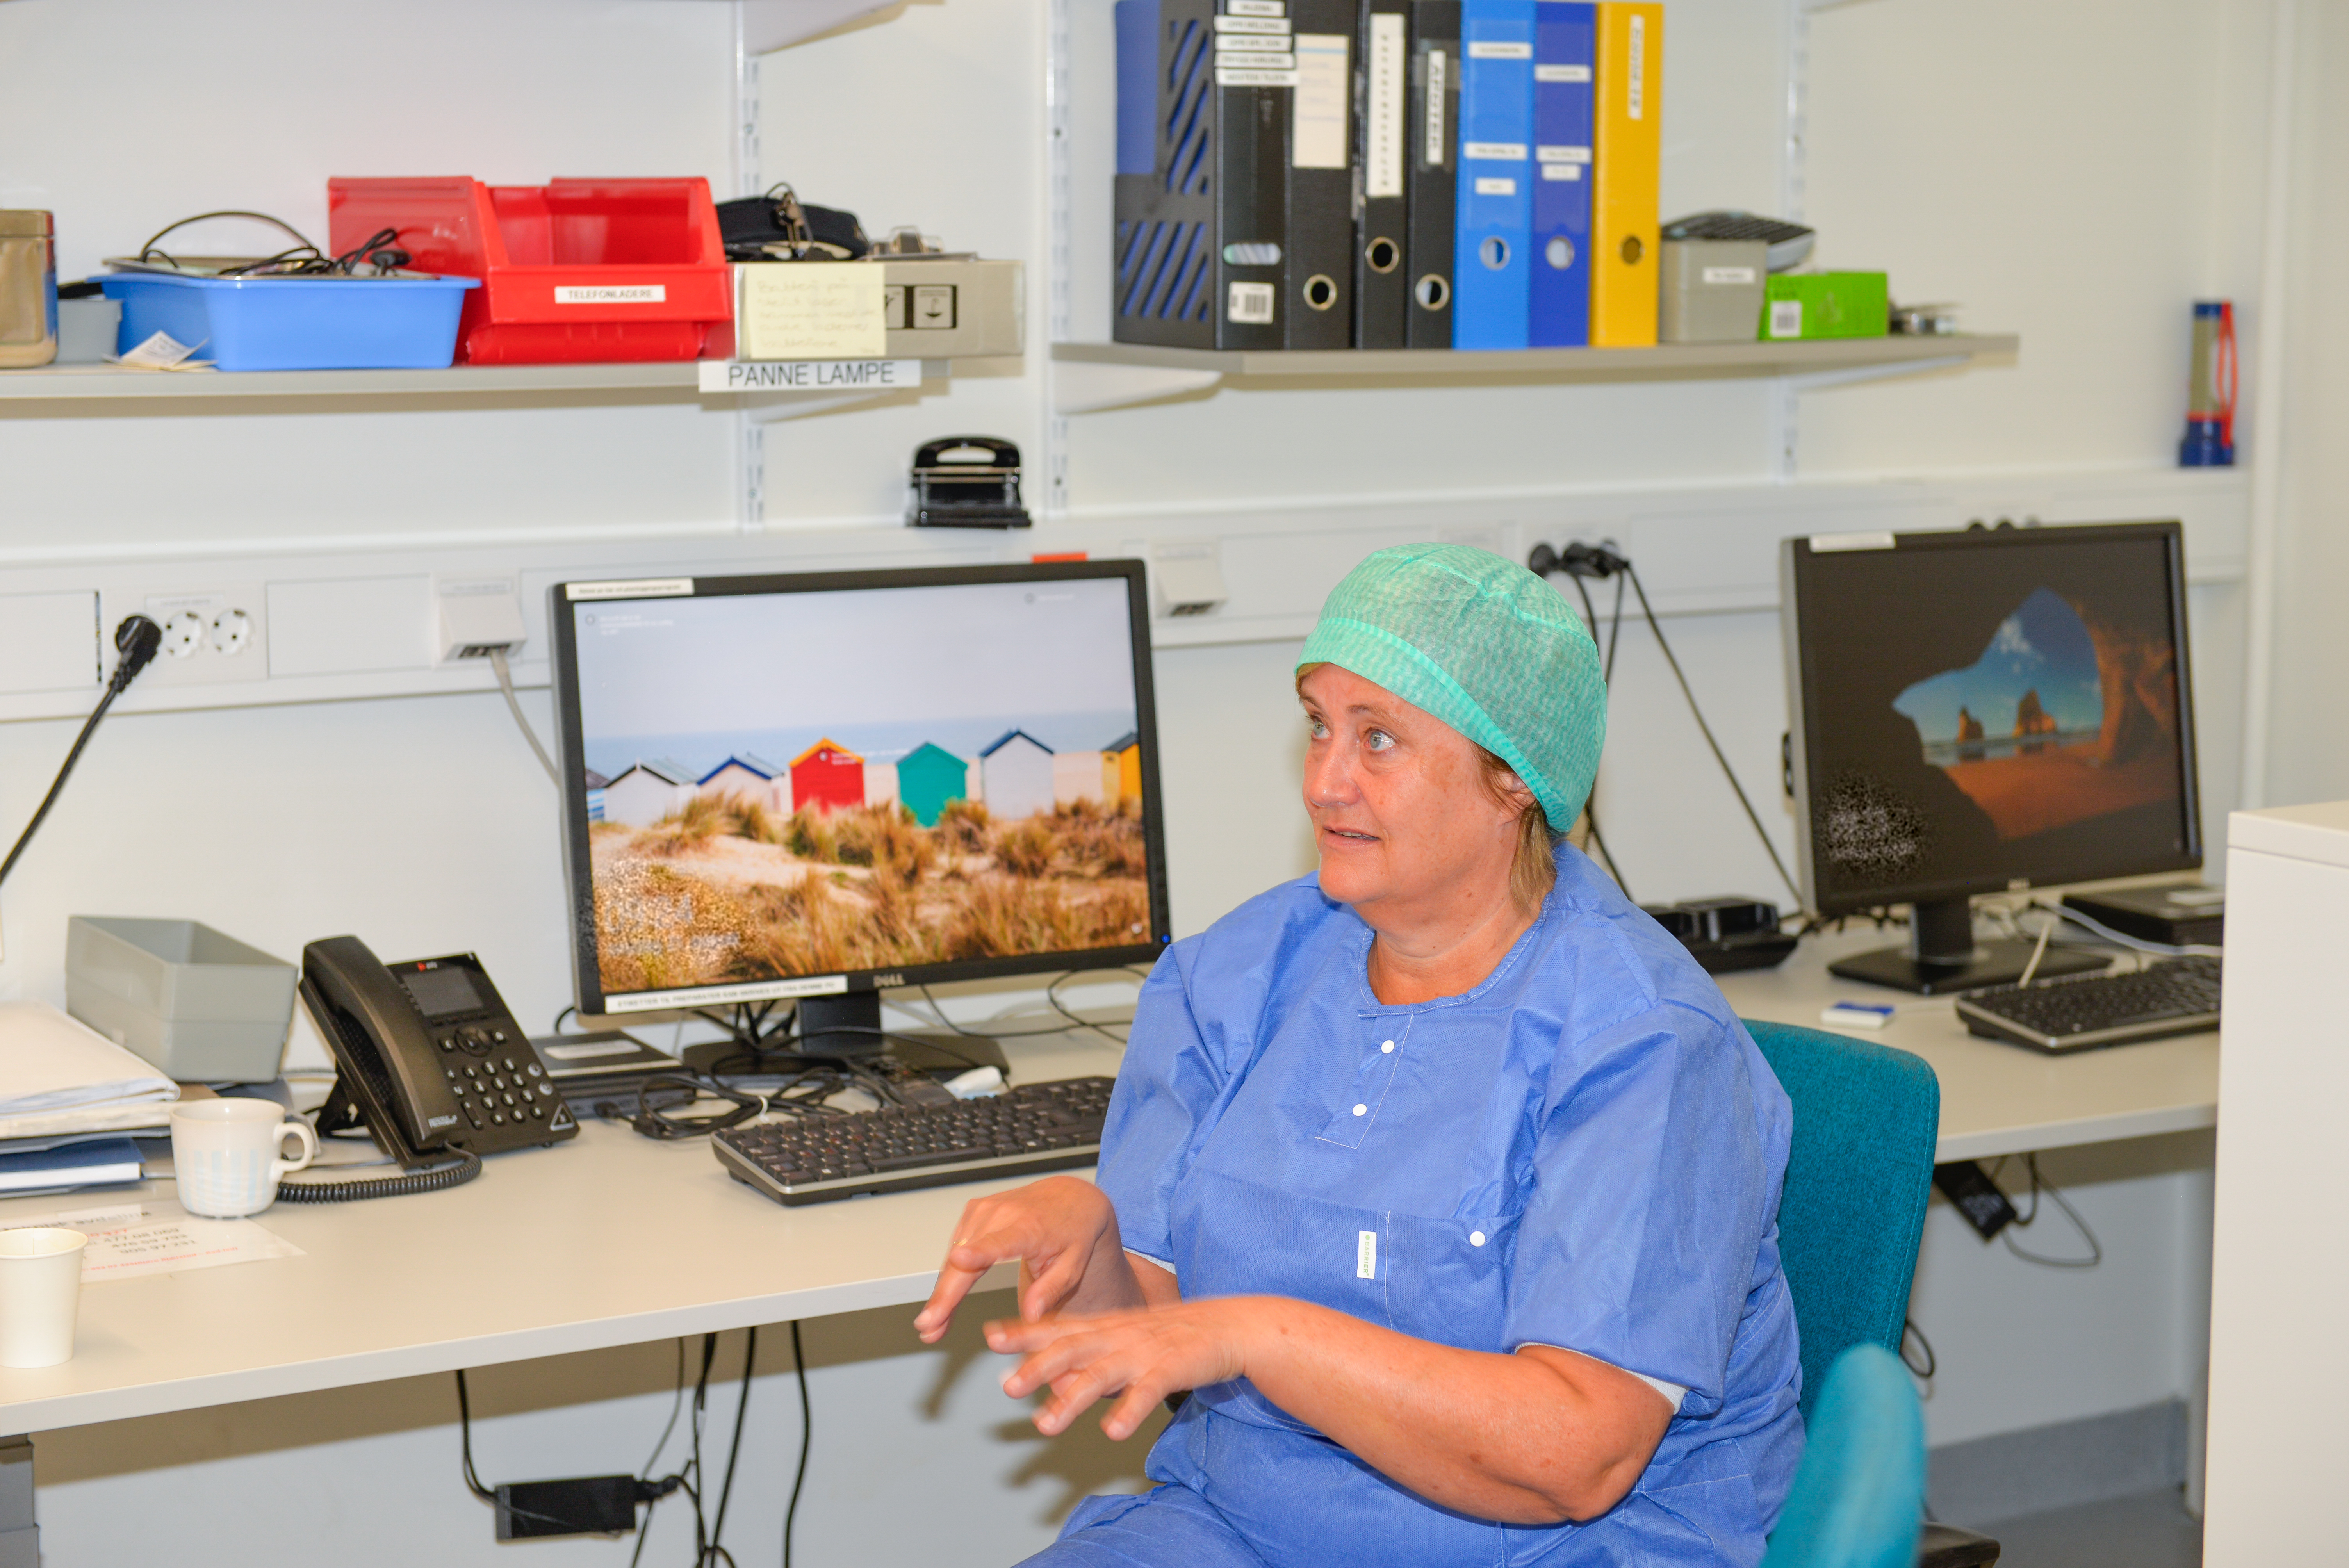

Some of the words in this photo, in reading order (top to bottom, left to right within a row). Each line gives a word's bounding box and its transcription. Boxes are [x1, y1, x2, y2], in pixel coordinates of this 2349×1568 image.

[1429, 64, 1443, 148] APOTEK
[568, 289, 653, 300] TELEFONLADERE
[728, 363, 809, 387] PANNE
[817, 361, 895, 385] LAMPE
[873, 974, 906, 987] DELL
